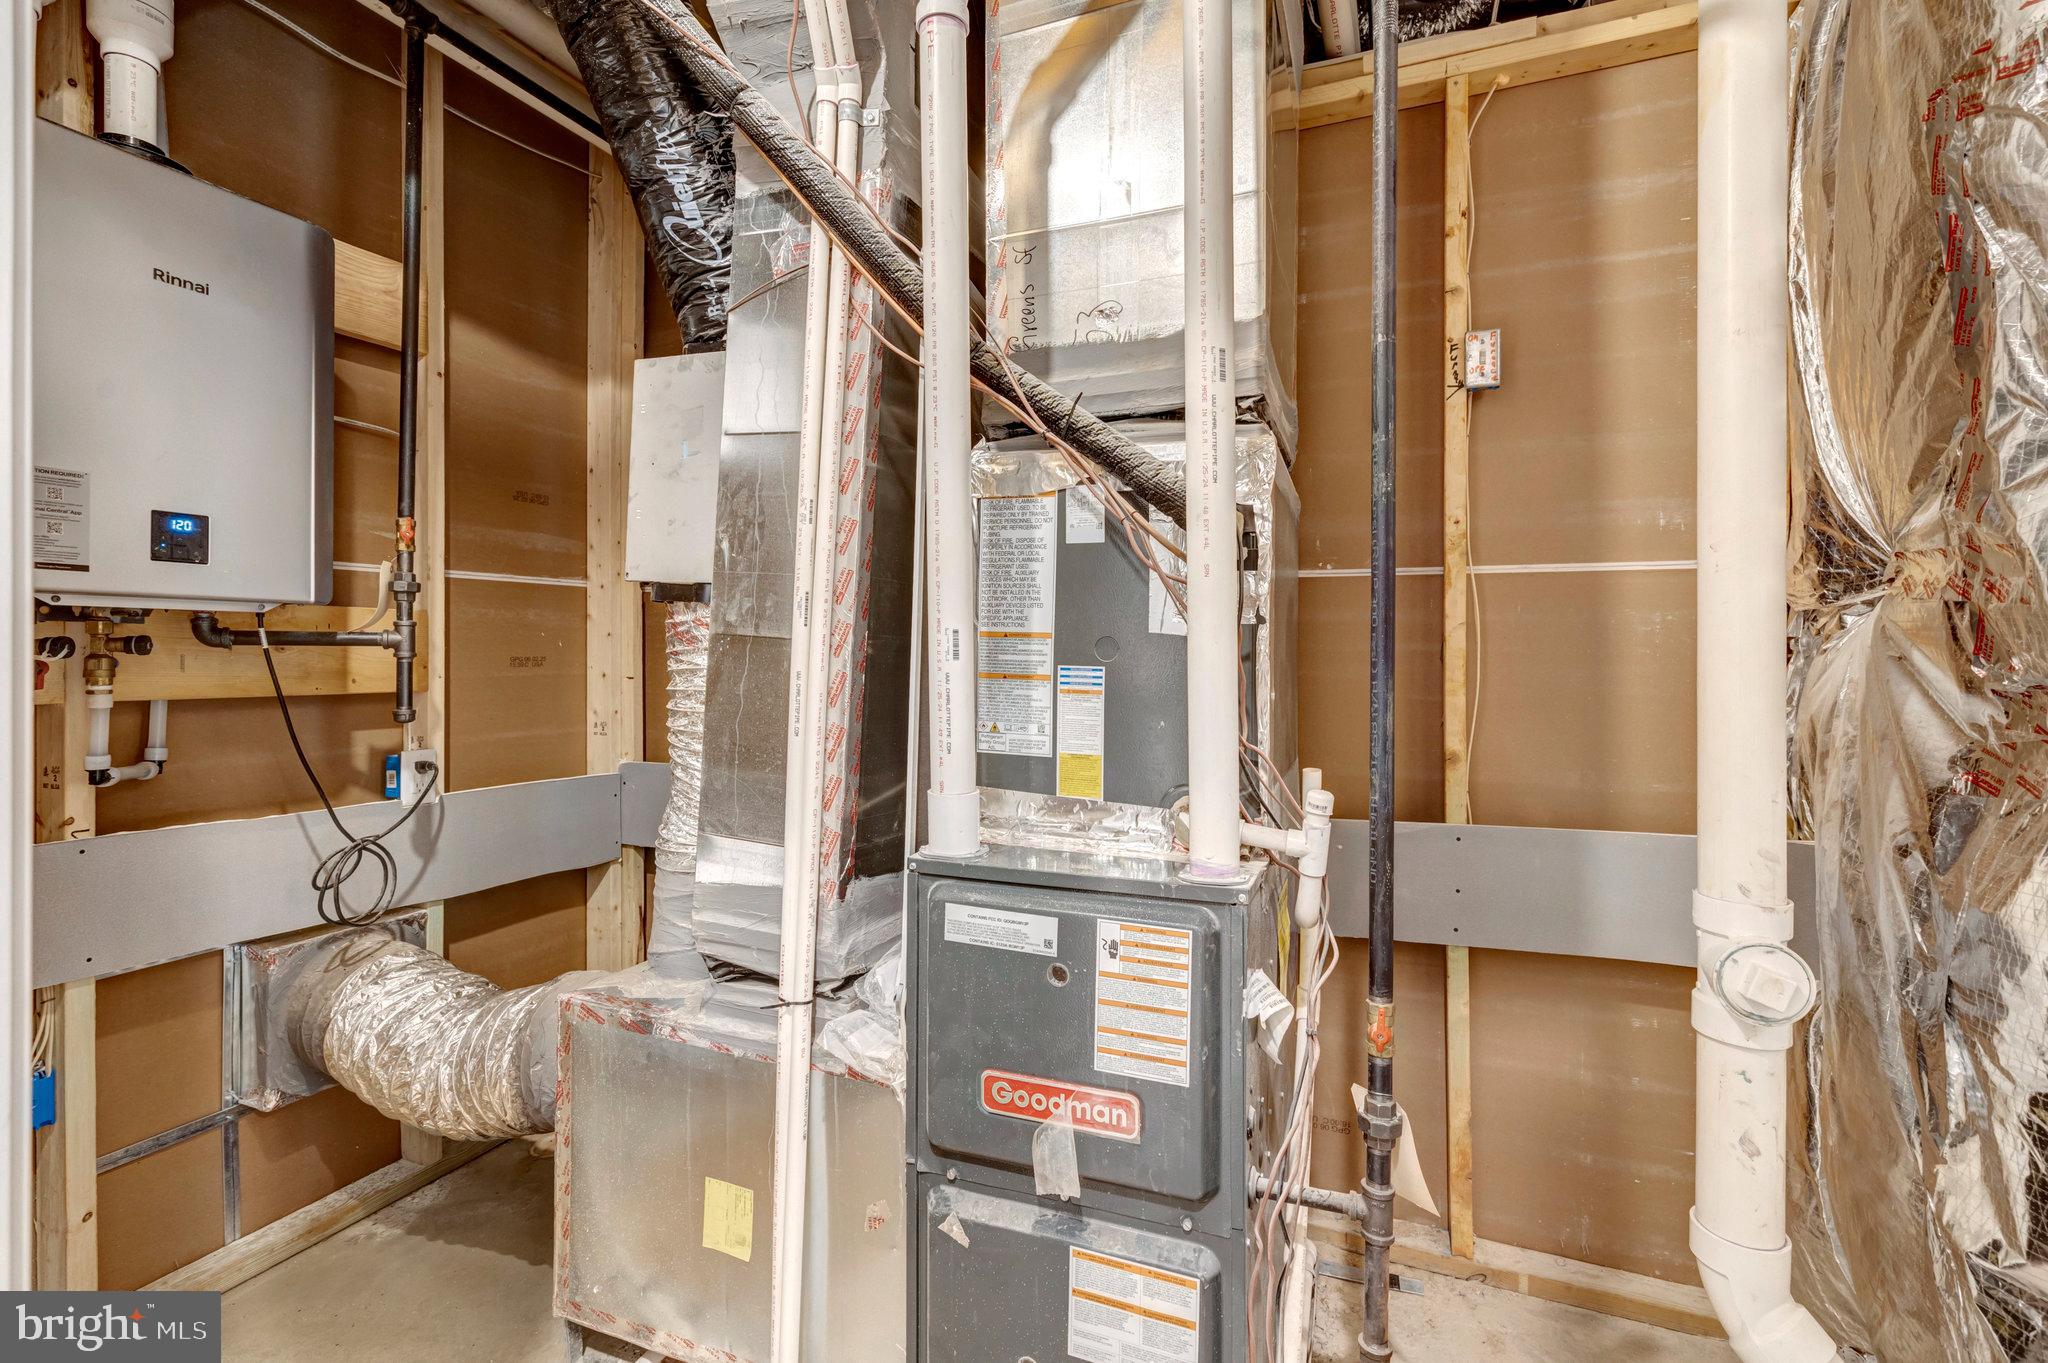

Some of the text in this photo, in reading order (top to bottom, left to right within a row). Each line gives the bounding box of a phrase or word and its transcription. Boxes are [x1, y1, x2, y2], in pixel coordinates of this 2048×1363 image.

[1013, 246, 1037, 264] St
[153, 268, 209, 295] Rinnai
[172, 520, 192, 531] 120
[992, 1082, 1127, 1128] Goodman
